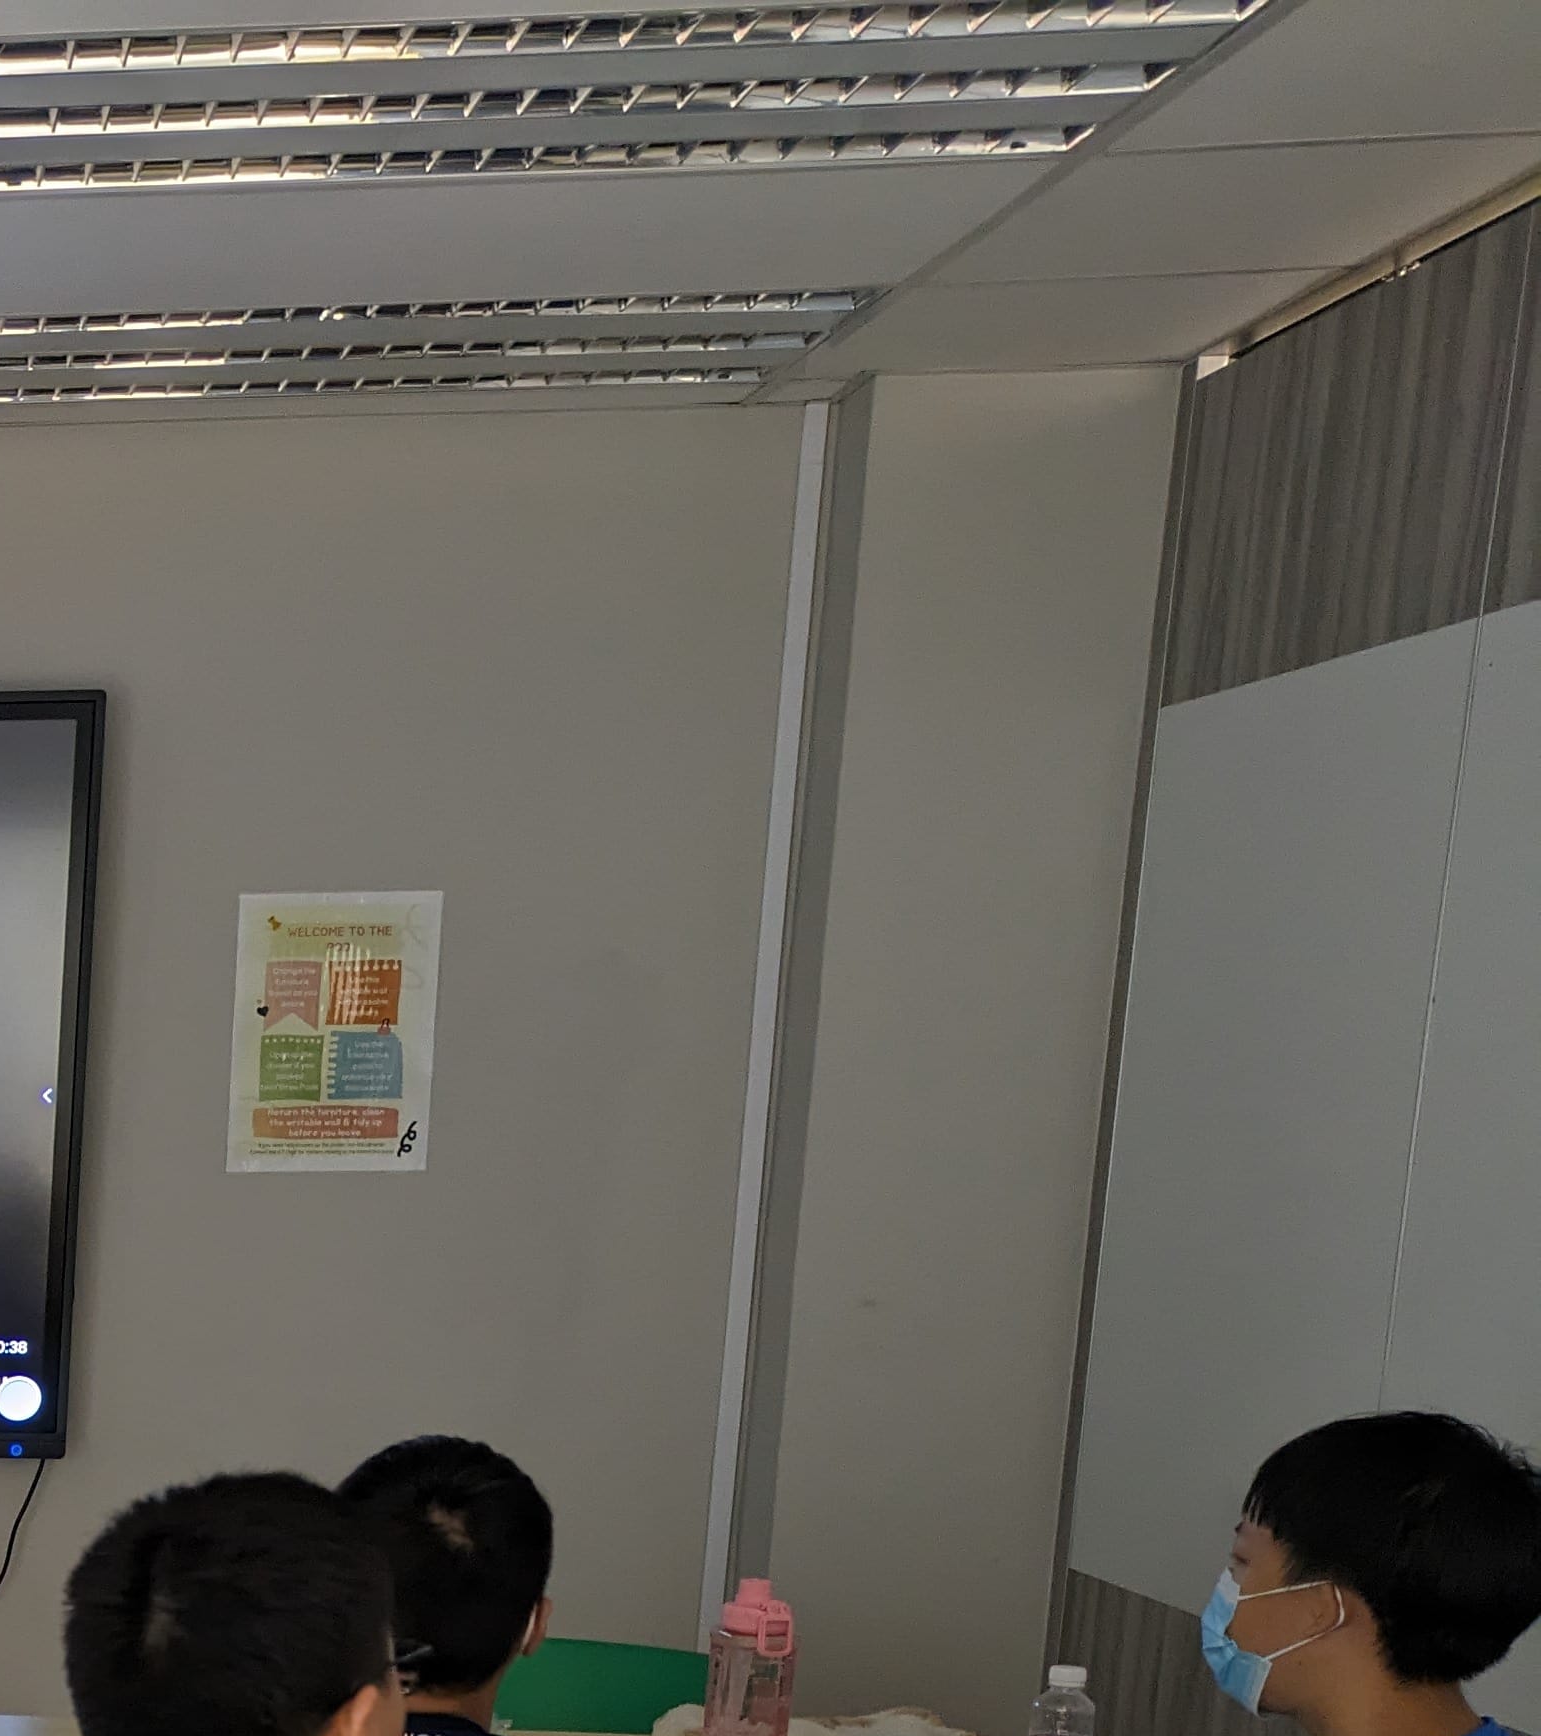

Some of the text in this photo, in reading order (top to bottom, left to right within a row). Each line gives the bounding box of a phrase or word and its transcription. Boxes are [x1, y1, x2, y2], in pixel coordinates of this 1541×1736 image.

[288, 925, 393, 938] WELCOME TO THE
